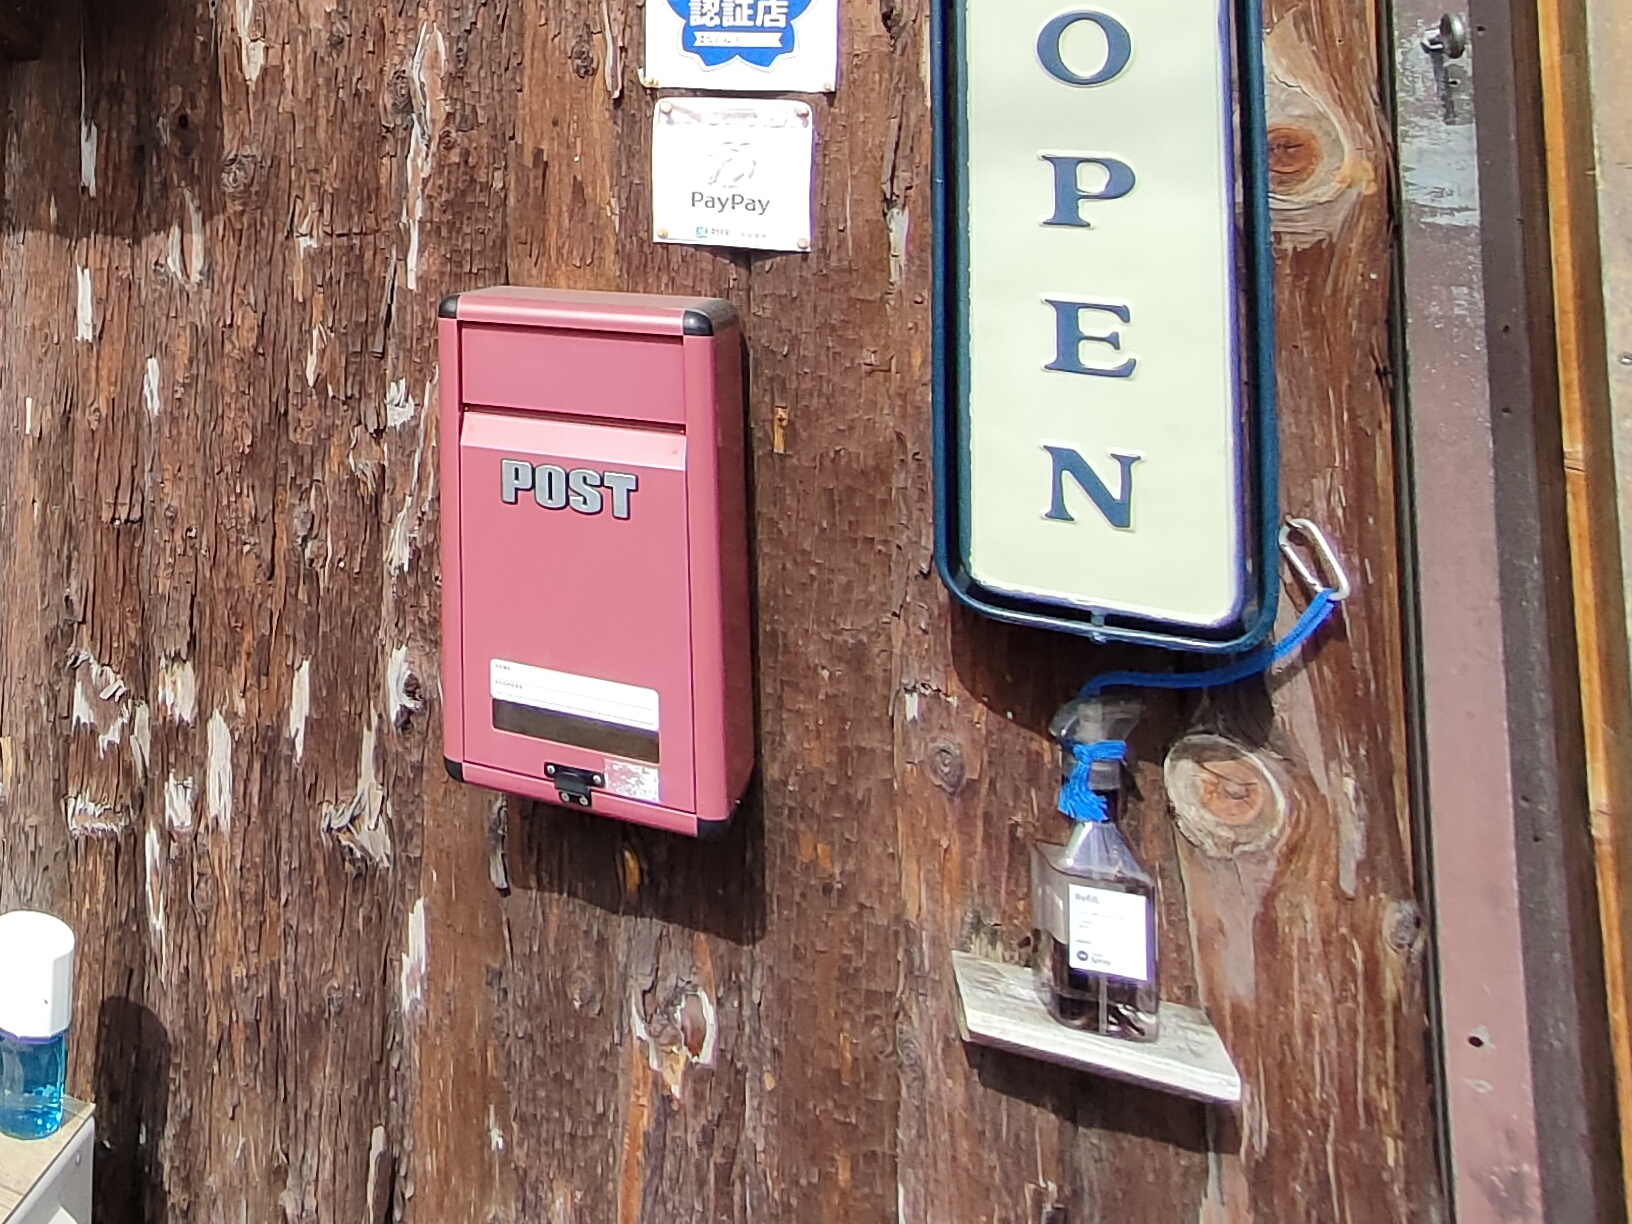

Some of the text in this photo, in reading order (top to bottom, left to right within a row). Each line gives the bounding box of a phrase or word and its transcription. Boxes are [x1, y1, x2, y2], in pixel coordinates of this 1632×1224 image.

[691, 191, 770, 216] PayPay
[1035, 8, 1139, 530] OPEN
[500, 458, 638, 520] POST
